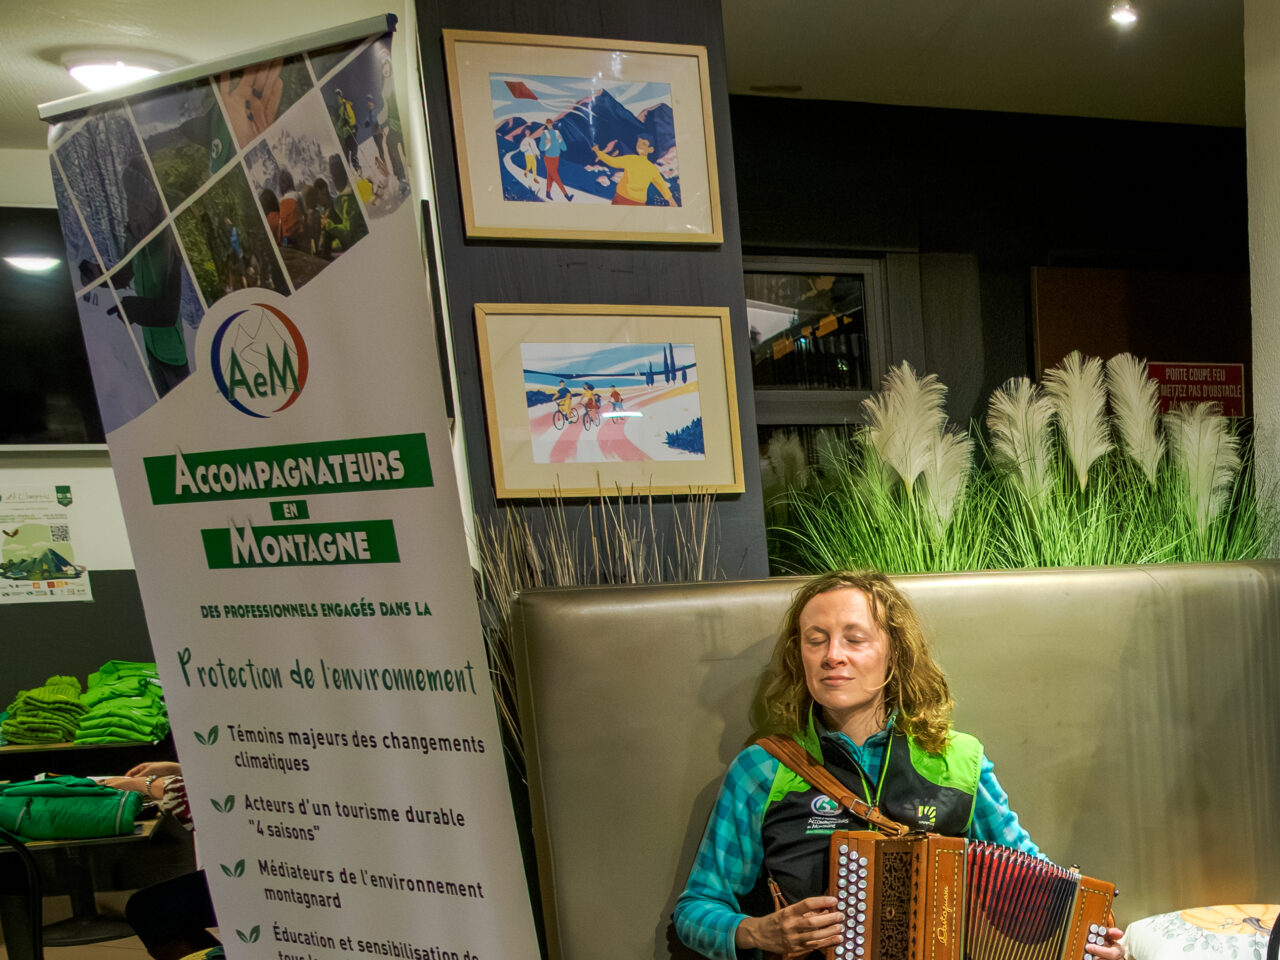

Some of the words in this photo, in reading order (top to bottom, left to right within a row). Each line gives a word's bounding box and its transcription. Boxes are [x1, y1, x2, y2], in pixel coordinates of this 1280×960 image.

[228, 341, 301, 400] AeM
[1165, 368, 1188, 381] PORTE
[1189, 368, 1211, 381] COUPE
[1212, 369, 1226, 381] FEU
[1188, 385, 1201, 397] PAS
[174, 445, 405, 495] ACCOMPAGNATEURS
[282, 502, 298, 518] EN
[228, 519, 371, 565] MONTAGNE
[200, 605, 222, 619] DES
[224, 602, 318, 619] PROFESSIONNELS
[320, 597, 376, 618] ENGAGÉS
[380, 601, 412, 617] DANS
[414, 601, 432, 617] LA
[177, 647, 283, 691] Protection
[290, 659, 315, 690] de
[320, 658, 477, 696] l'environnement
[227, 724, 285, 745] Témoins
[289, 729, 348, 750] majeurs
[352, 731, 377, 749] des
[382, 731, 485, 754] changements
[234, 751, 310, 775] climatiques
[245, 794, 295, 815] Acteurs
[299, 797, 332, 818] d'un
[336, 798, 400, 823] tourisme
[405, 806, 465, 828] durable
[267, 820, 320, 842] saisons"
[258, 859, 335, 885] Médiateurs
[339, 867, 357, 885] de
[361, 869, 485, 900] l'environnement
[264, 886, 342, 909] montagnard
[273, 920, 336, 949] Éducation
[339, 933, 354, 951] et
